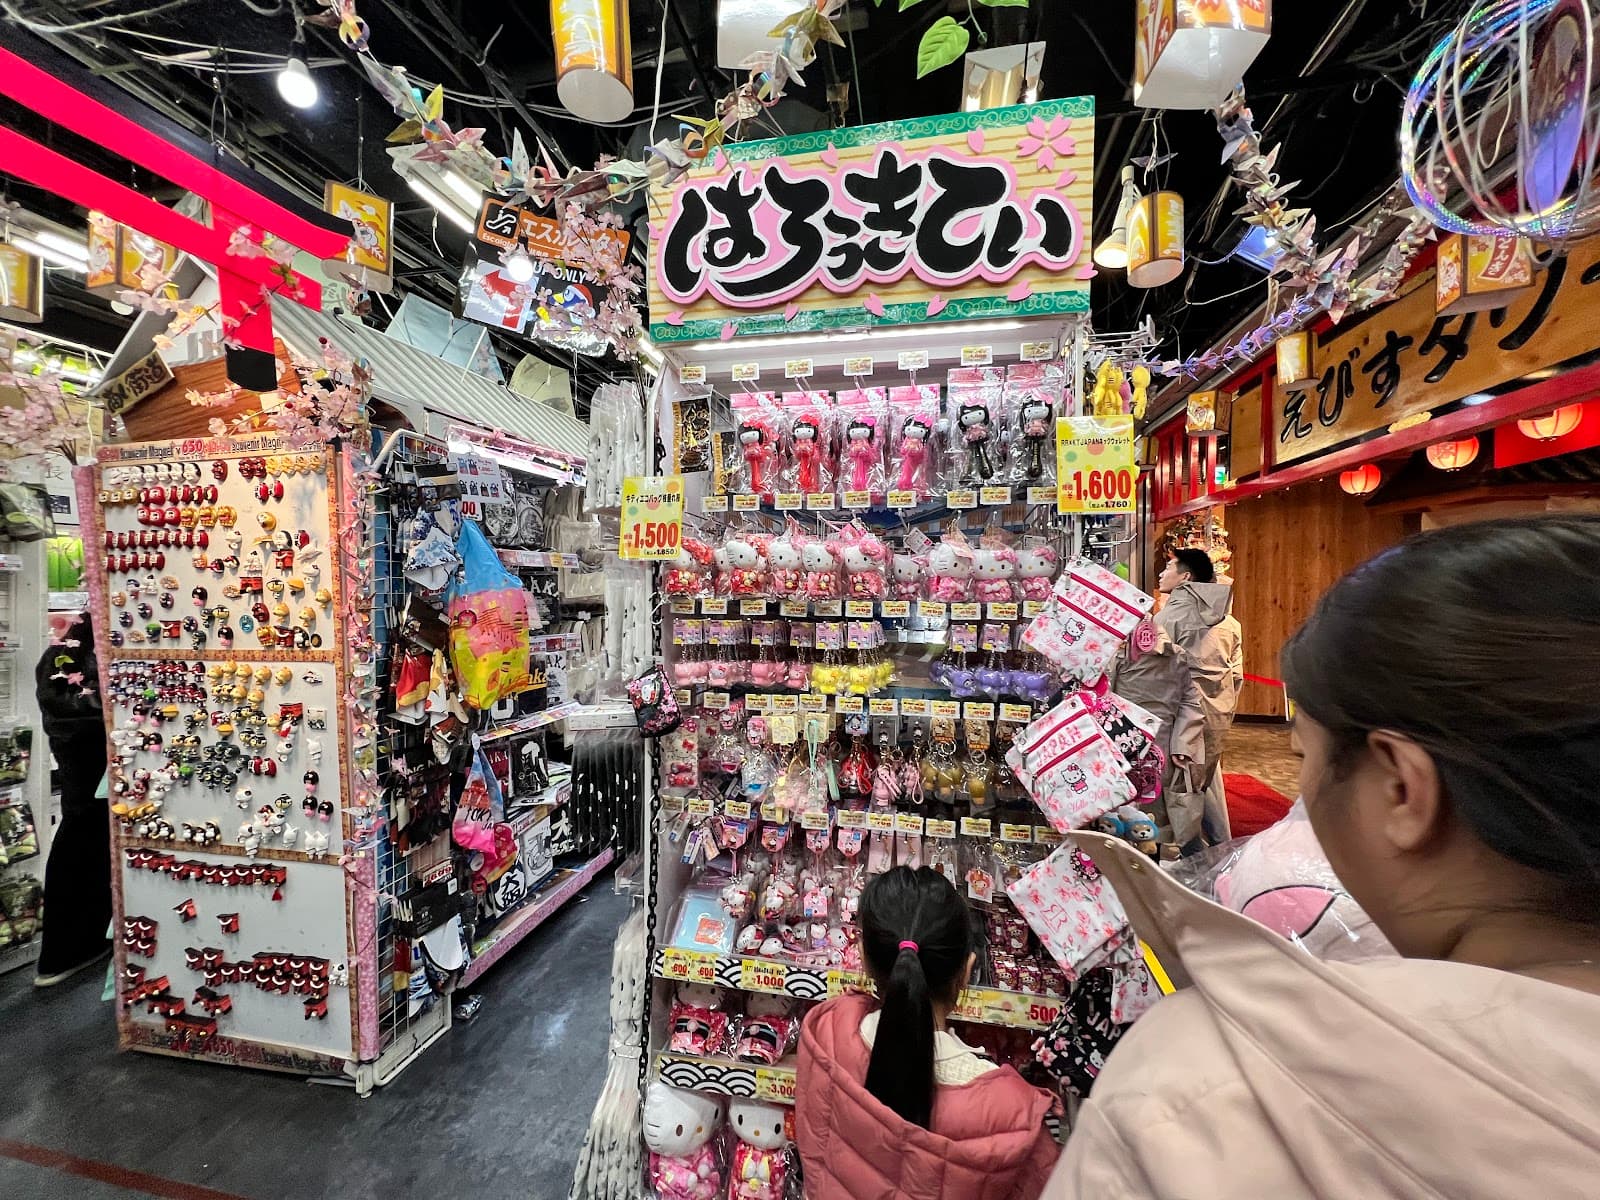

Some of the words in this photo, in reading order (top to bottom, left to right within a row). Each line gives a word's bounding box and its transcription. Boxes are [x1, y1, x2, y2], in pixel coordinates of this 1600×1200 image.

[182, 440, 203, 455] 650
[1073, 469, 1132, 501] 1,600
[633, 522, 679, 549] 1,500
[1086, 1011, 1132, 1041] JAP
